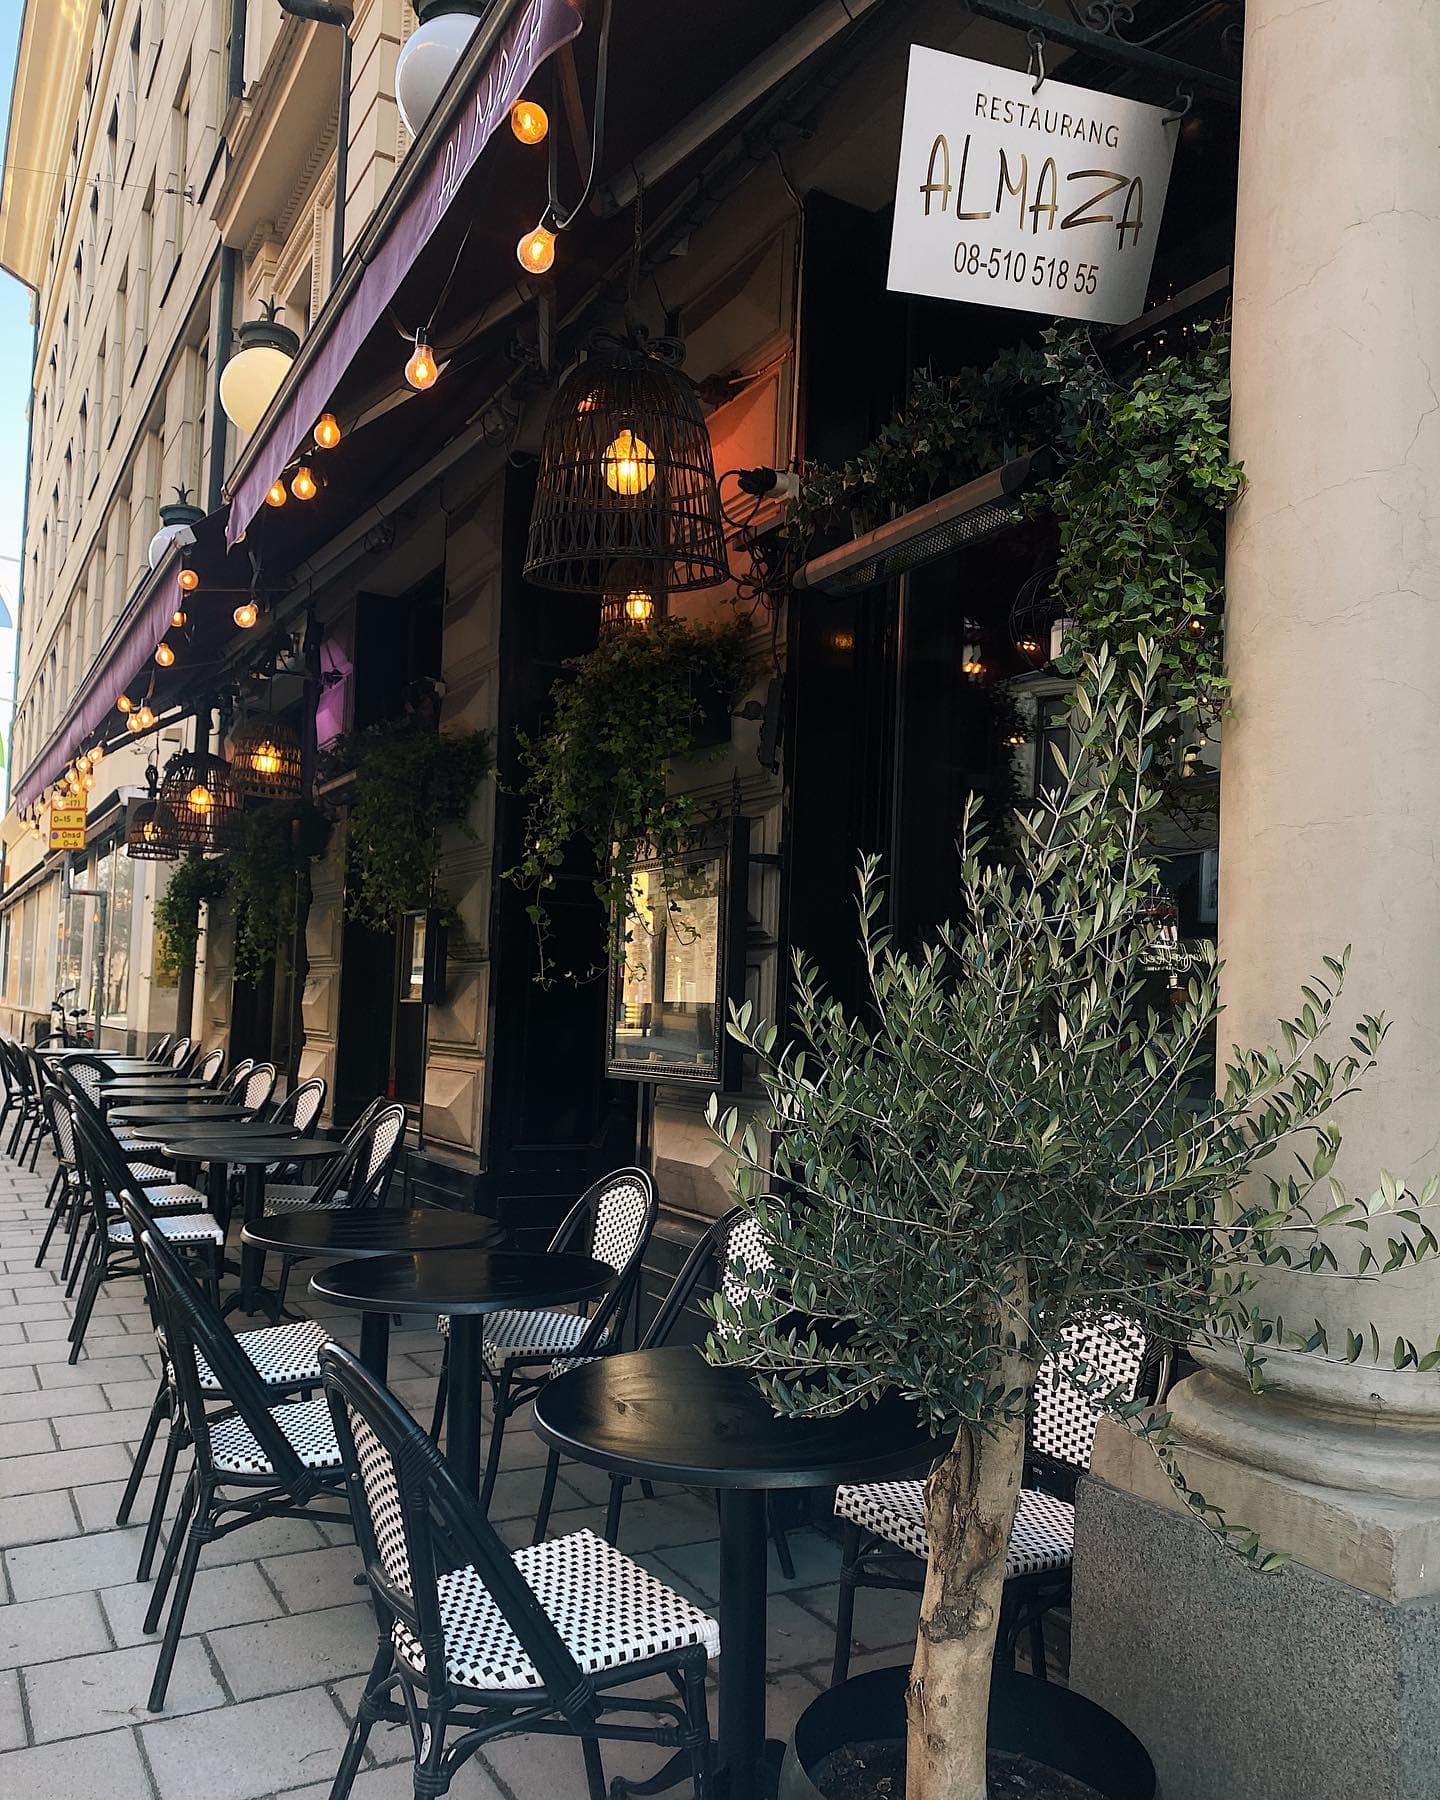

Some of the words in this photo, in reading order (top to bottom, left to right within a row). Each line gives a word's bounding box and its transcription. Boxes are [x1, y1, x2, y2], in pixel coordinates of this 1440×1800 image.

[975, 92, 1120, 149] RESTAURANG
[919, 133, 1144, 250] ALMAZA
[954, 241, 1027, 283] 08-510
[1032, 255, 1070, 290] 518
[1073, 263, 1100, 295] 55
[53, 815, 71, 823] 0-15
